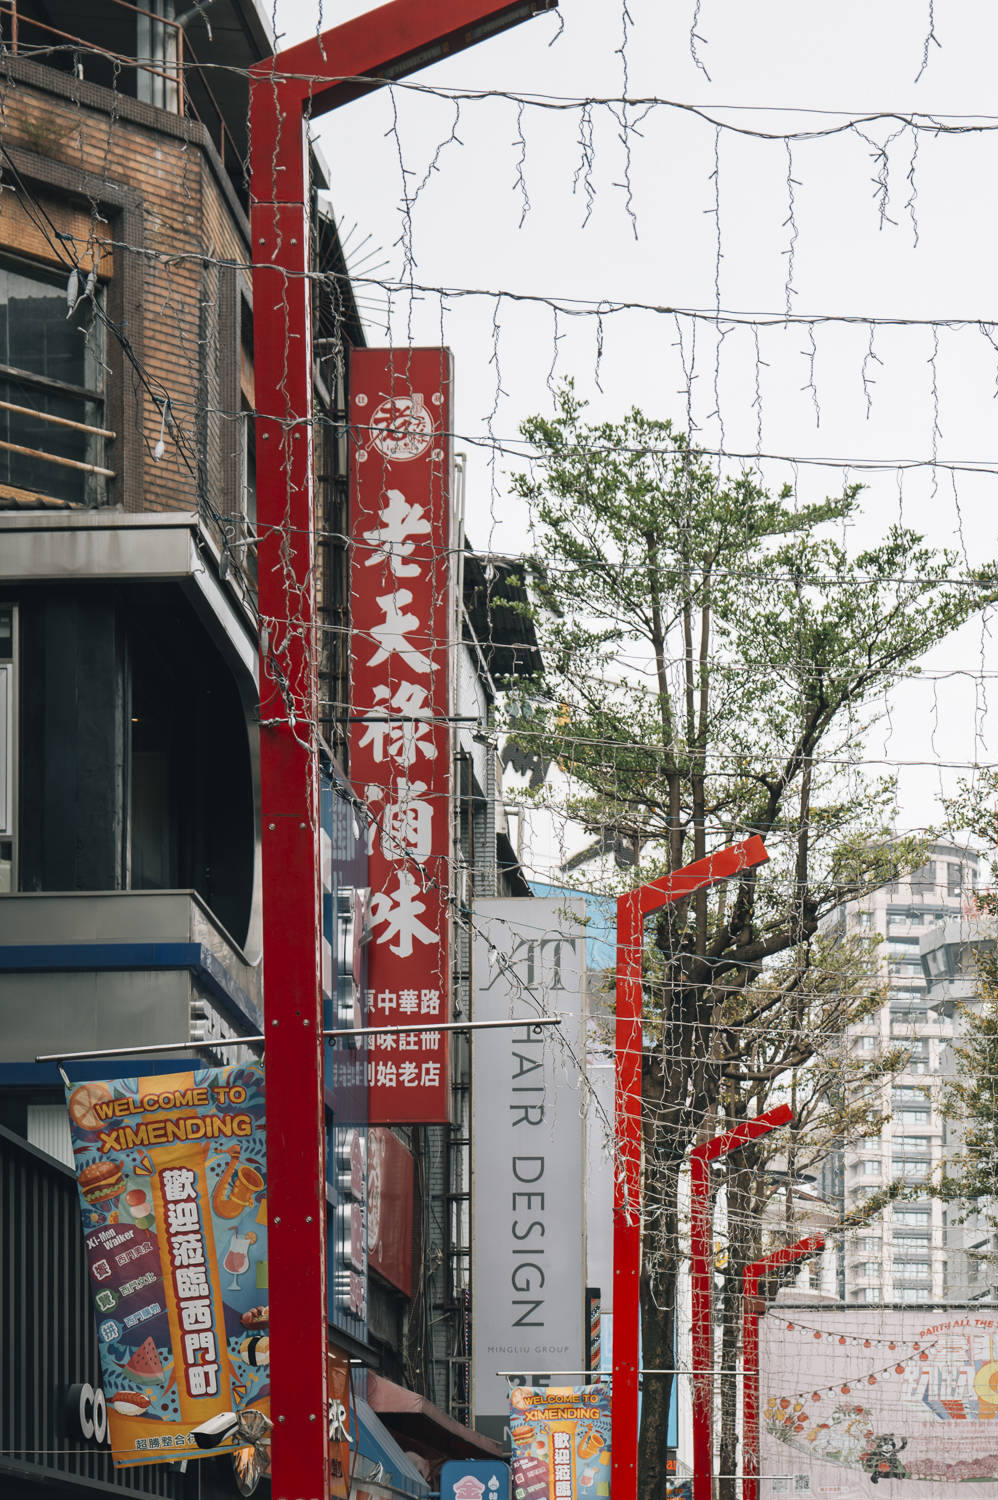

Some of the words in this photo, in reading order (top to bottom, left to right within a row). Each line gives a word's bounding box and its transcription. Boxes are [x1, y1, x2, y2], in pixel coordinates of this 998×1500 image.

[94, 1094, 209, 1121] WELCOME
[213, 1085, 246, 1106] TO
[101, 1114, 252, 1153] XIMENDING
[103, 1229, 135, 1250] Walker
[511, 1156, 545, 1327] DESIGN
[119, 1272, 157, 1296] 西門文化
[162, 1168, 219, 1397] 歡迎蒞臨西門町
[919, 1321, 951, 1338] PARTY
[953, 1319, 970, 1327] ALL
[974, 1319, 994, 1328] THE
[487, 1346, 529, 1354] MINGLIU
[535, 1346, 569, 1354] GROUP
[524, 1394, 579, 1405] WELCOME
[583, 1394, 599, 1402] TO
[525, 1408, 600, 1421] XIMENDING
